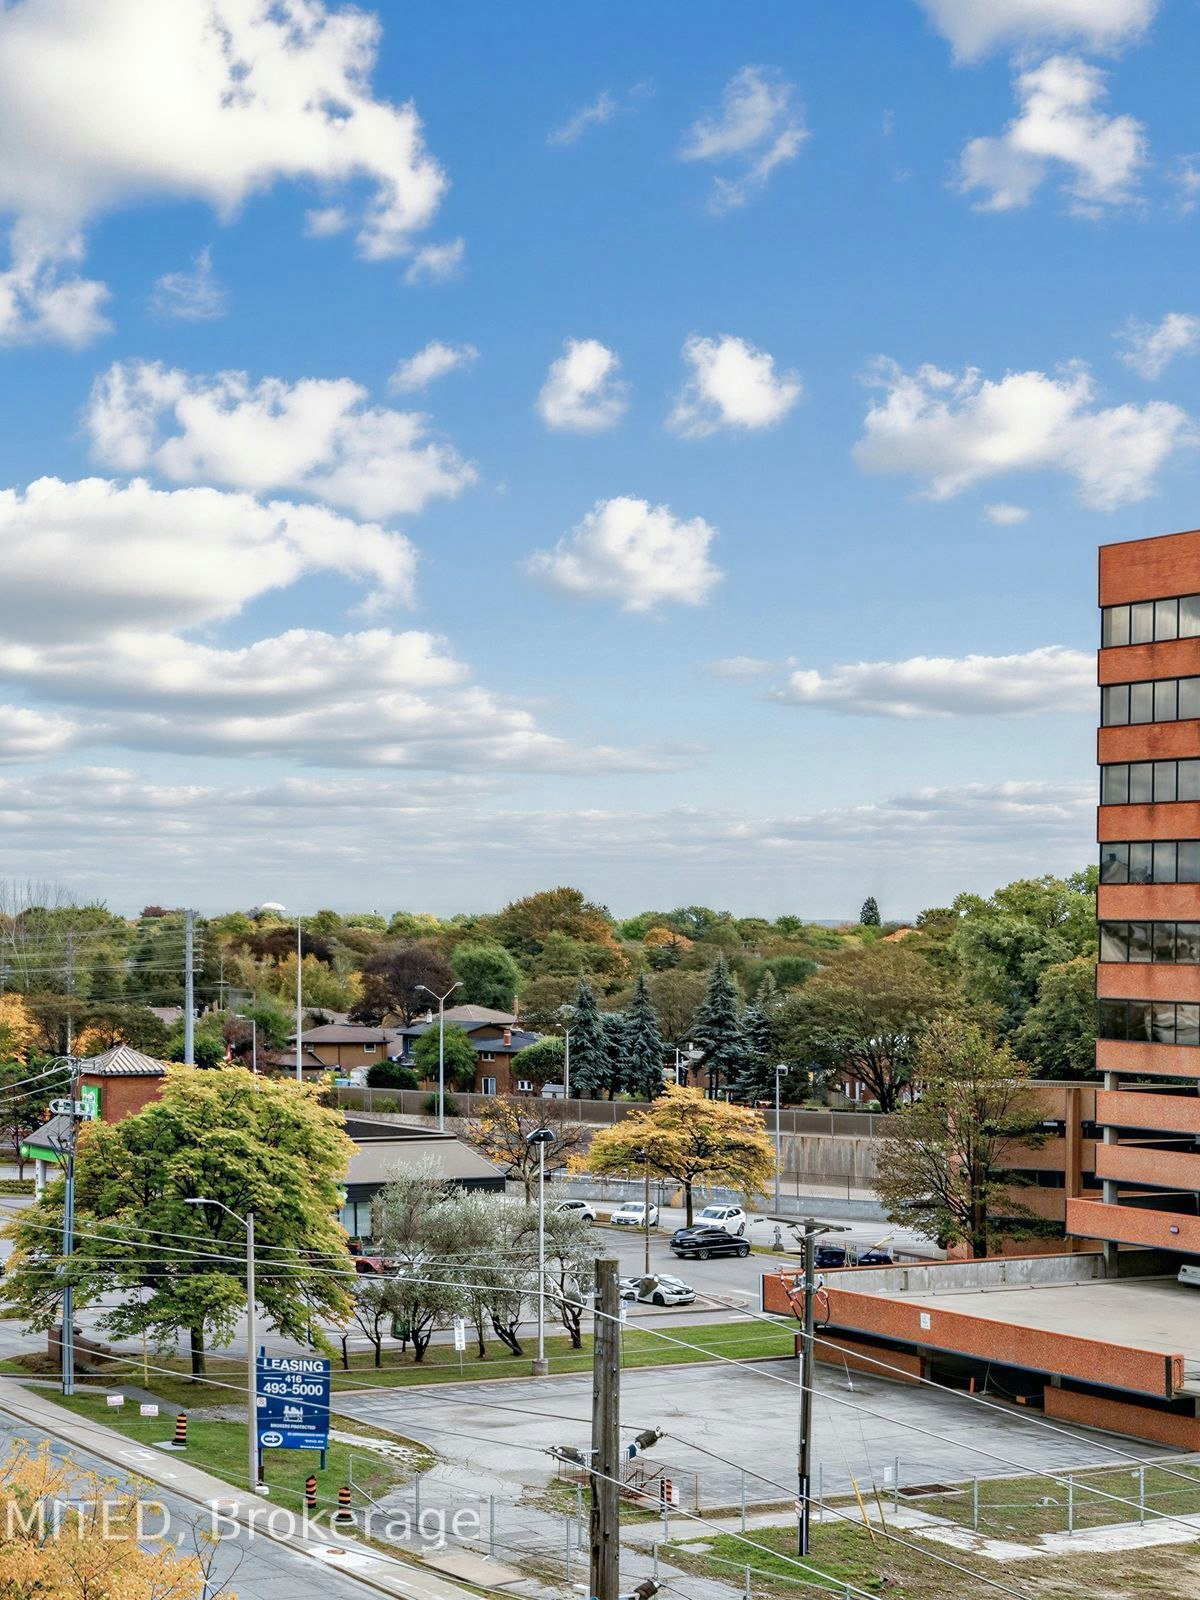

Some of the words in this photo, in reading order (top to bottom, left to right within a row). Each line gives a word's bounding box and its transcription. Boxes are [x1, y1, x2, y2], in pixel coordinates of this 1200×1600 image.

[263, 1358, 324, 1372] LEASING
[285, 1375, 302, 1383] 416
[263, 1383, 324, 1396] 493-5000
